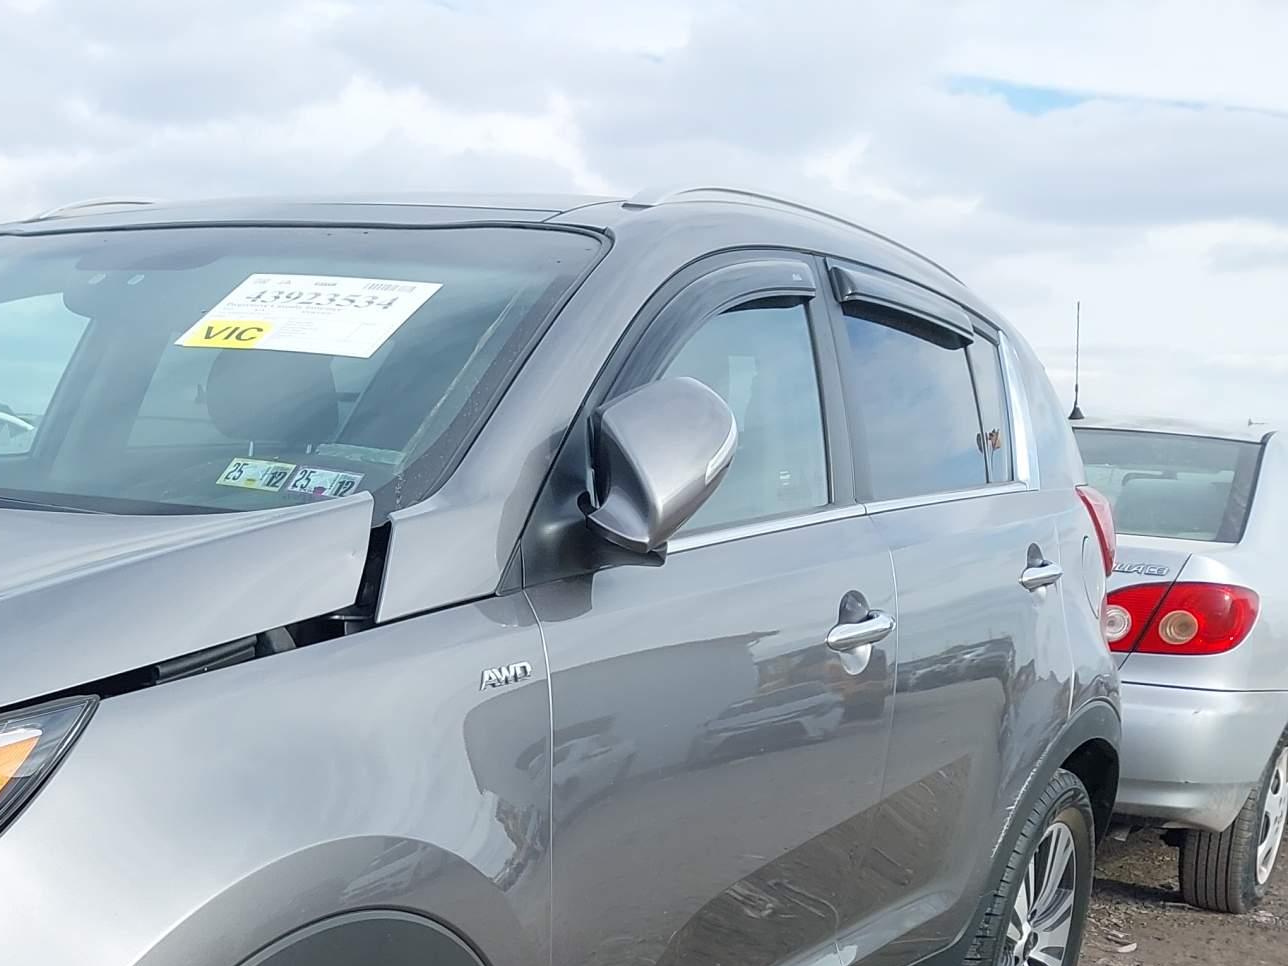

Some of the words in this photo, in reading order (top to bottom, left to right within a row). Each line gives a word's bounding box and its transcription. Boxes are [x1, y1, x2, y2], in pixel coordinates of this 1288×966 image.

[246, 289, 399, 310] 43923534
[203, 325, 264, 342] VIC
[225, 463, 249, 481] 25
[264, 471, 288, 488] 12
[292, 470, 318, 489] 25
[333, 480, 357, 497] 12
[479, 661, 532, 690] AWD
